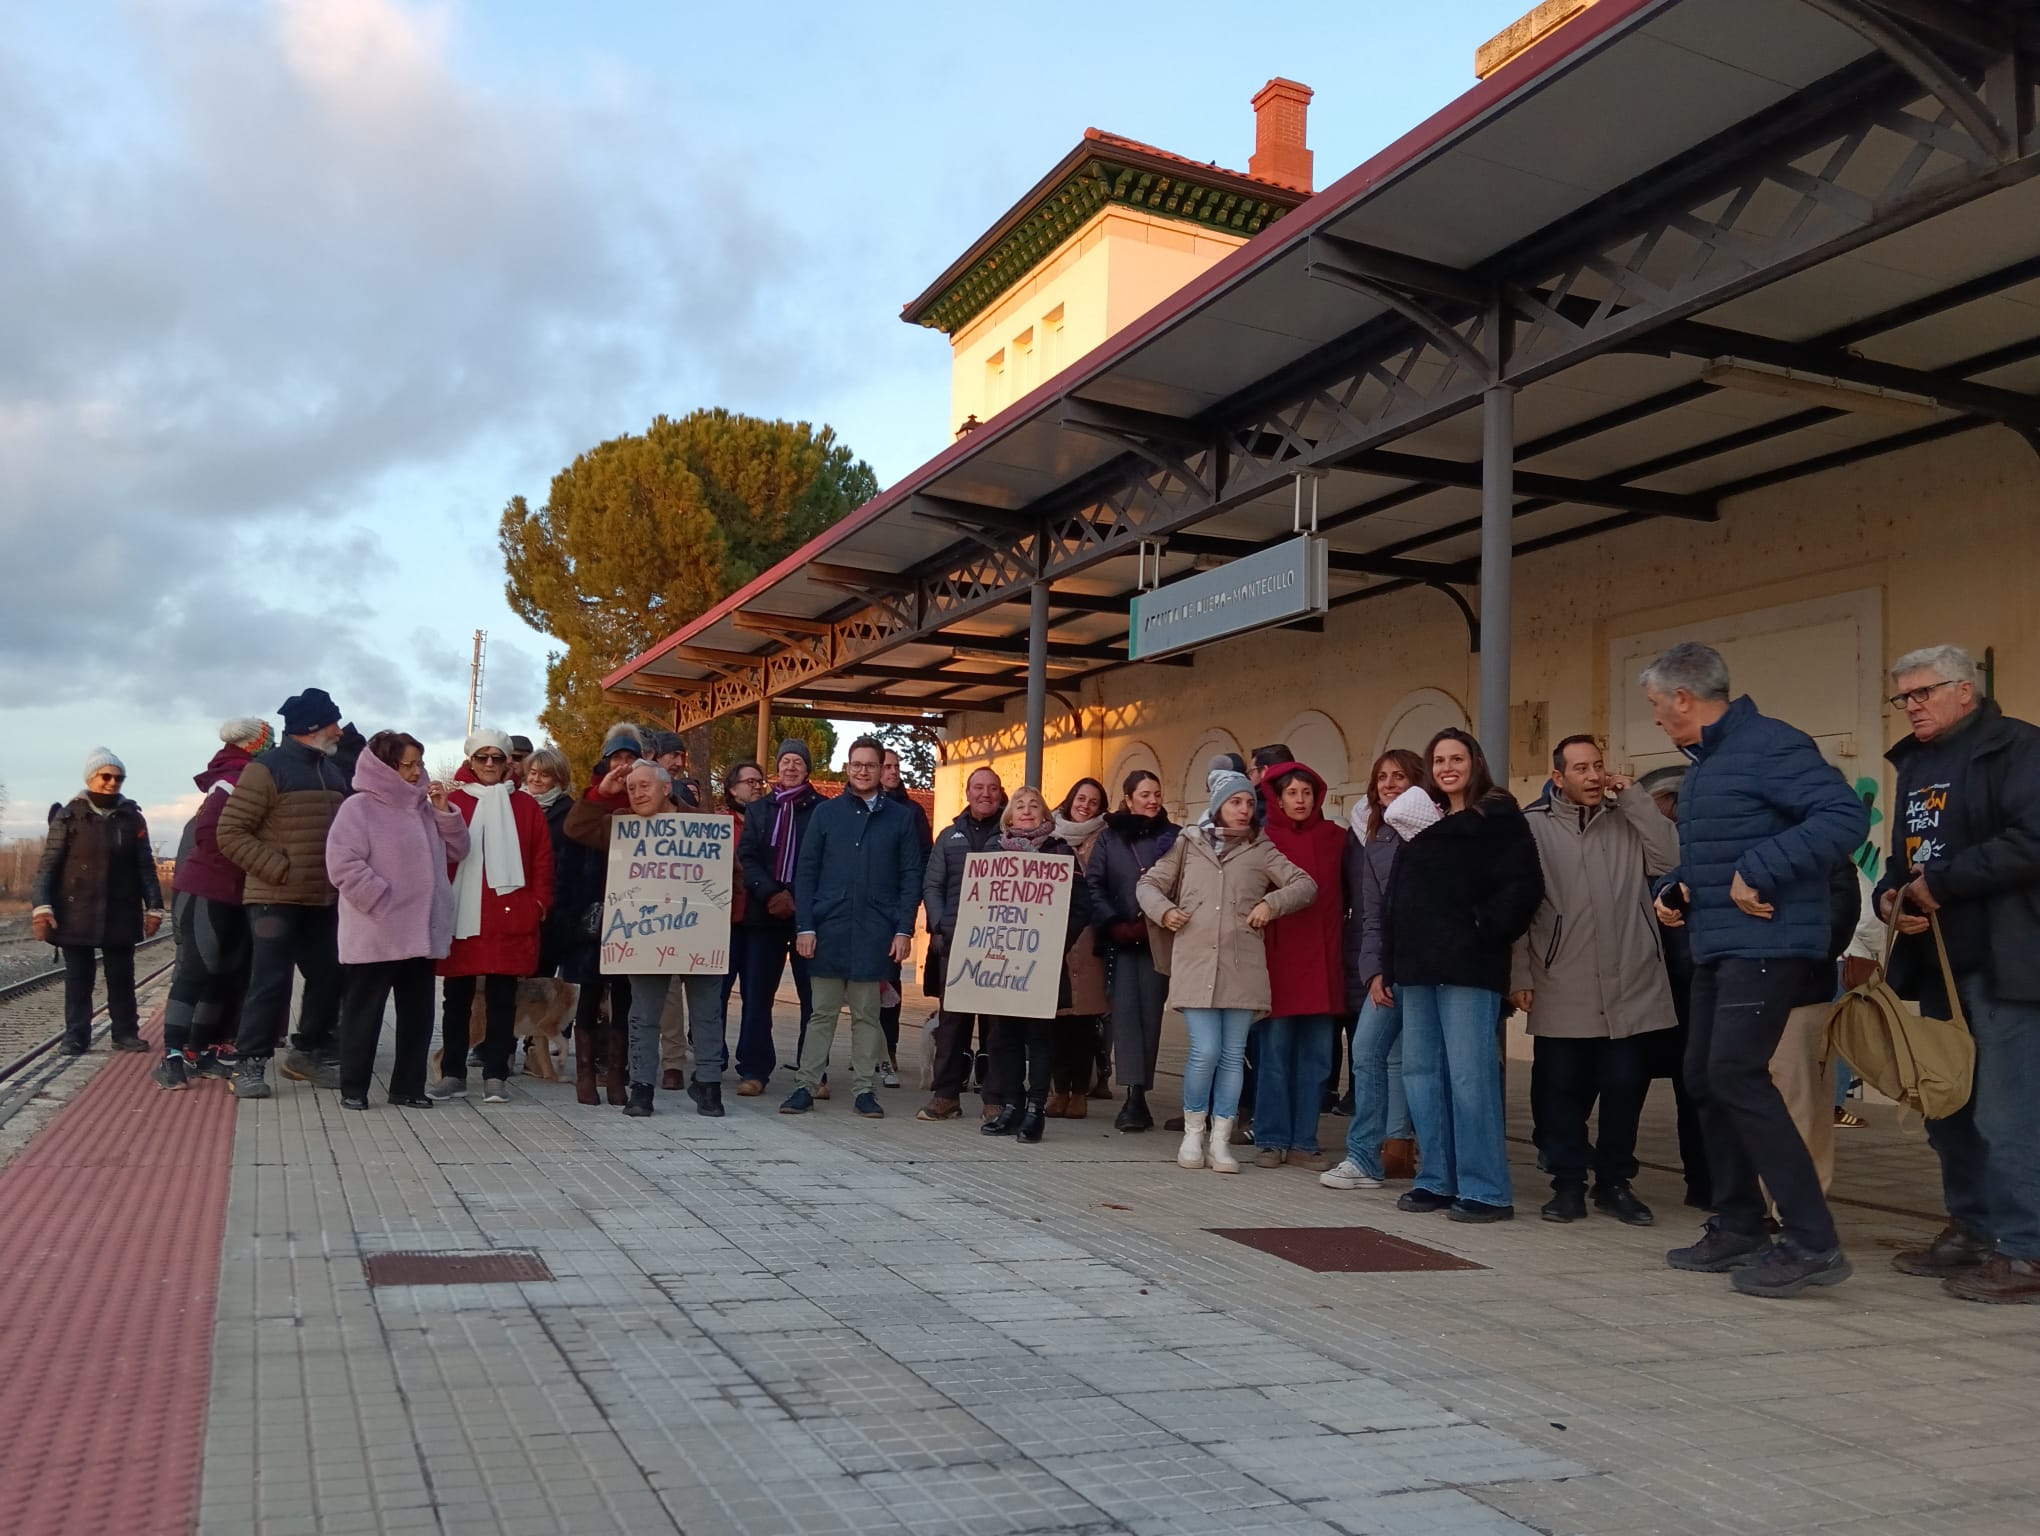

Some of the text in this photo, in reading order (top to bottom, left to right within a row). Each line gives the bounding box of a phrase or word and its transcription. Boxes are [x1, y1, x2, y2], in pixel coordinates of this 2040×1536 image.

[617, 819, 731, 840] NO NOS VAMOS
[1907, 811, 1939, 832] TREN
[633, 840, 721, 860] A CALLAR
[629, 862, 703, 881] DIRECTO
[968, 857, 1069, 882] NO NOS VAMOS
[967, 880, 1054, 905] A RENDIR
[602, 897, 698, 945] Aranda
[639, 905, 658, 919] por
[988, 905, 1028, 924] TREN
[968, 926, 1040, 953] DIRECTO
[947, 958, 1037, 992] Madrid
